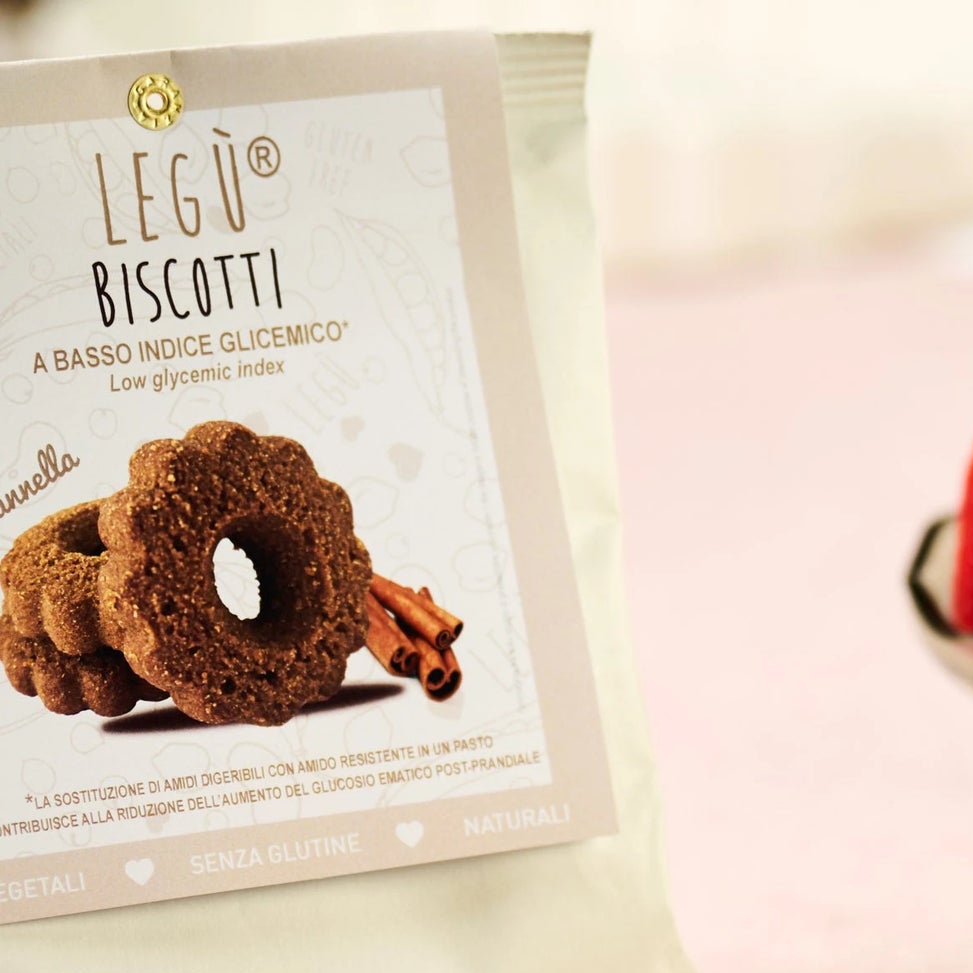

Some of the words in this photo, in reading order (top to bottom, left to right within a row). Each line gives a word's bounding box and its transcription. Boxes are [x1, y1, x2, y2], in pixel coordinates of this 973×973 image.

[91, 247, 283, 328] BISCOTTI
[32, 352, 49, 375] A
[53, 343, 133, 372] BASSO
[138, 334, 214, 362] INDICE
[110, 373, 148, 393] Low
[152, 361, 232, 393] glycemic
[237, 358, 285, 379] index
[54, 782, 146, 807] SOSTITUZIONE
[148, 779, 162, 794] DI
[163, 773, 200, 792] AMIDI
[201, 765, 266, 788] DIGERIBILI
[267, 762, 296, 779] CON
[297, 757, 338, 775] AMIDO
[340, 744, 416, 769] RESISTENTE
[417, 743, 431, 759] IN
[432, 740, 451, 757] UN
[453, 735, 495, 753] PASTO
[81, 808, 115, 825] ALLA
[117, 801, 186, 822] RIDUZIONE
[188, 787, 282, 811] DELL'AUMENTO
[284, 782, 311, 800] DEL
[311, 772, 377, 797] GLUCOSIO
[378, 766, 434, 787] EMATICO
[436, 751, 541, 776] POST-PRANDIALE
[190, 848, 264, 875] SENZA
[267, 833, 361, 863] GLUTINE
[463, 804, 571, 837] NATURALI
